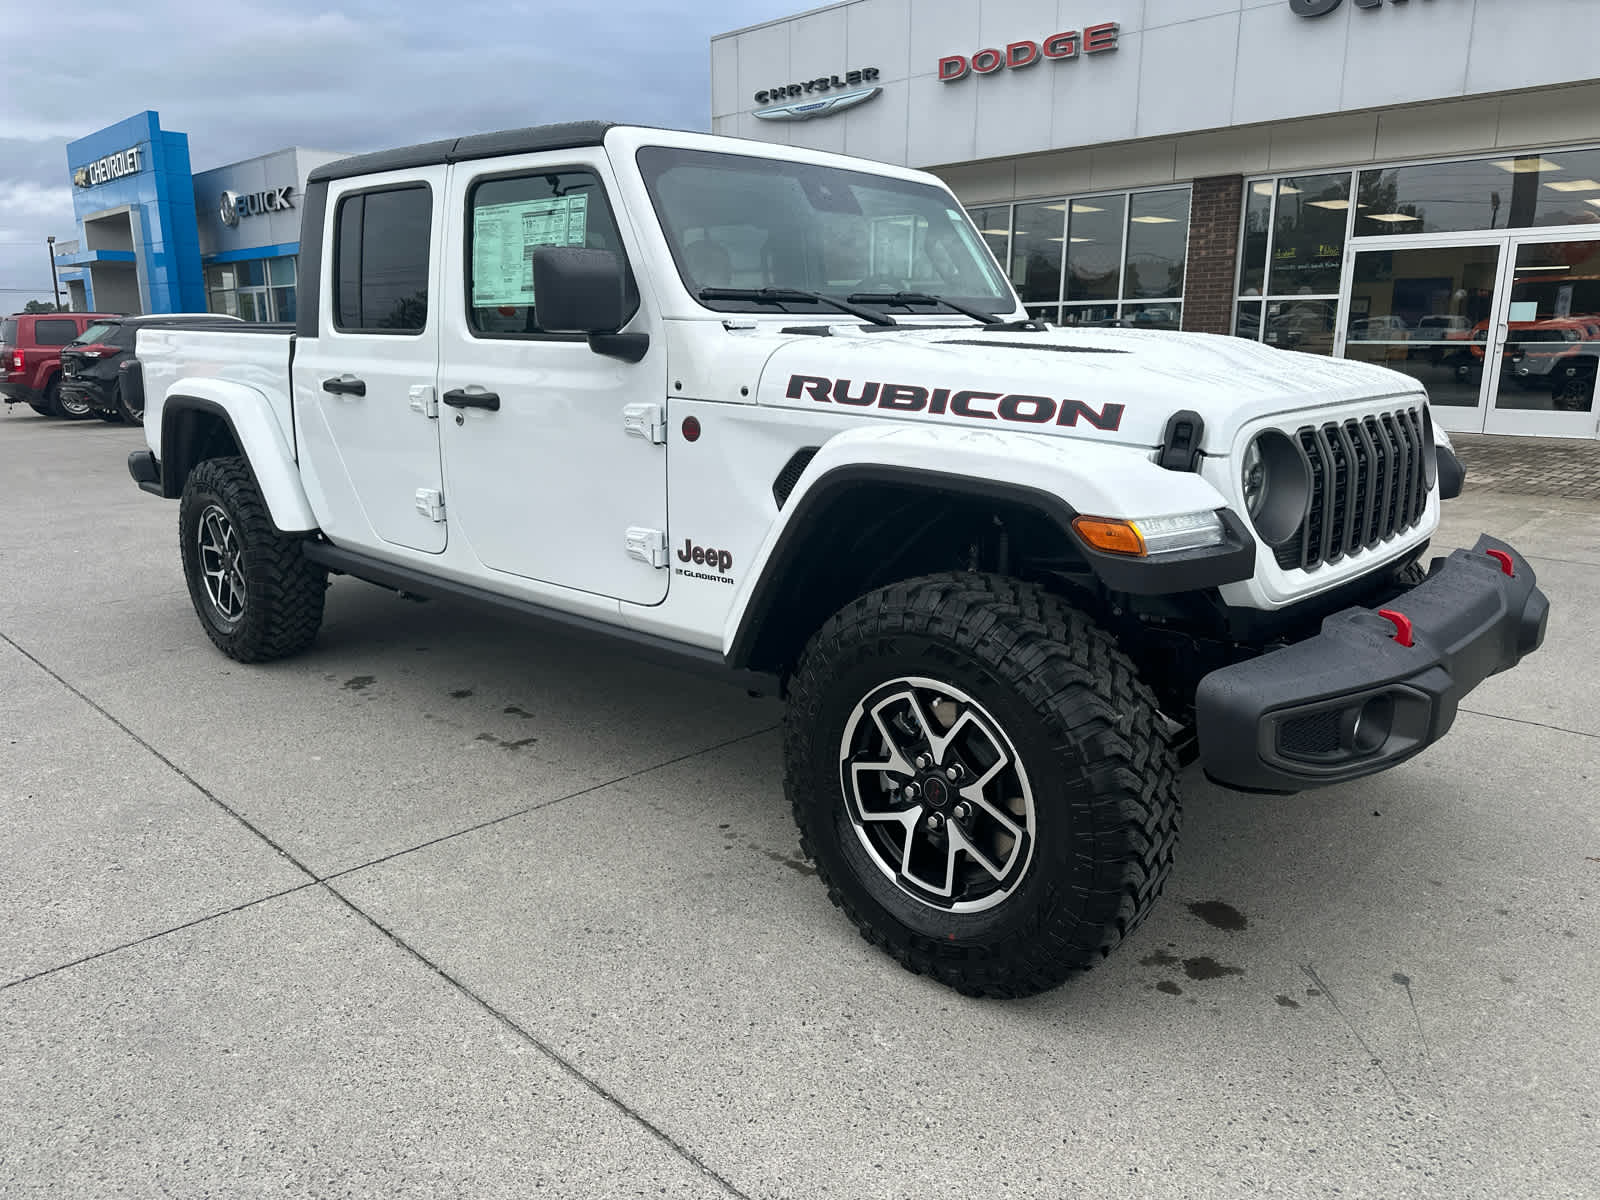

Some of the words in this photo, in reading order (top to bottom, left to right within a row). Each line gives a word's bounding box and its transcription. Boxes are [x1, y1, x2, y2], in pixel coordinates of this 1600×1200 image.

[938, 22, 1120, 83] DODGE
[754, 67, 880, 104] CHRYSLER
[89, 147, 141, 184] CHEVROLET
[235, 186, 294, 217] BUICK
[785, 374, 1126, 431] RUBICON
[677, 538, 732, 573] Jeep
[683, 569, 735, 584] GLADIATOR
